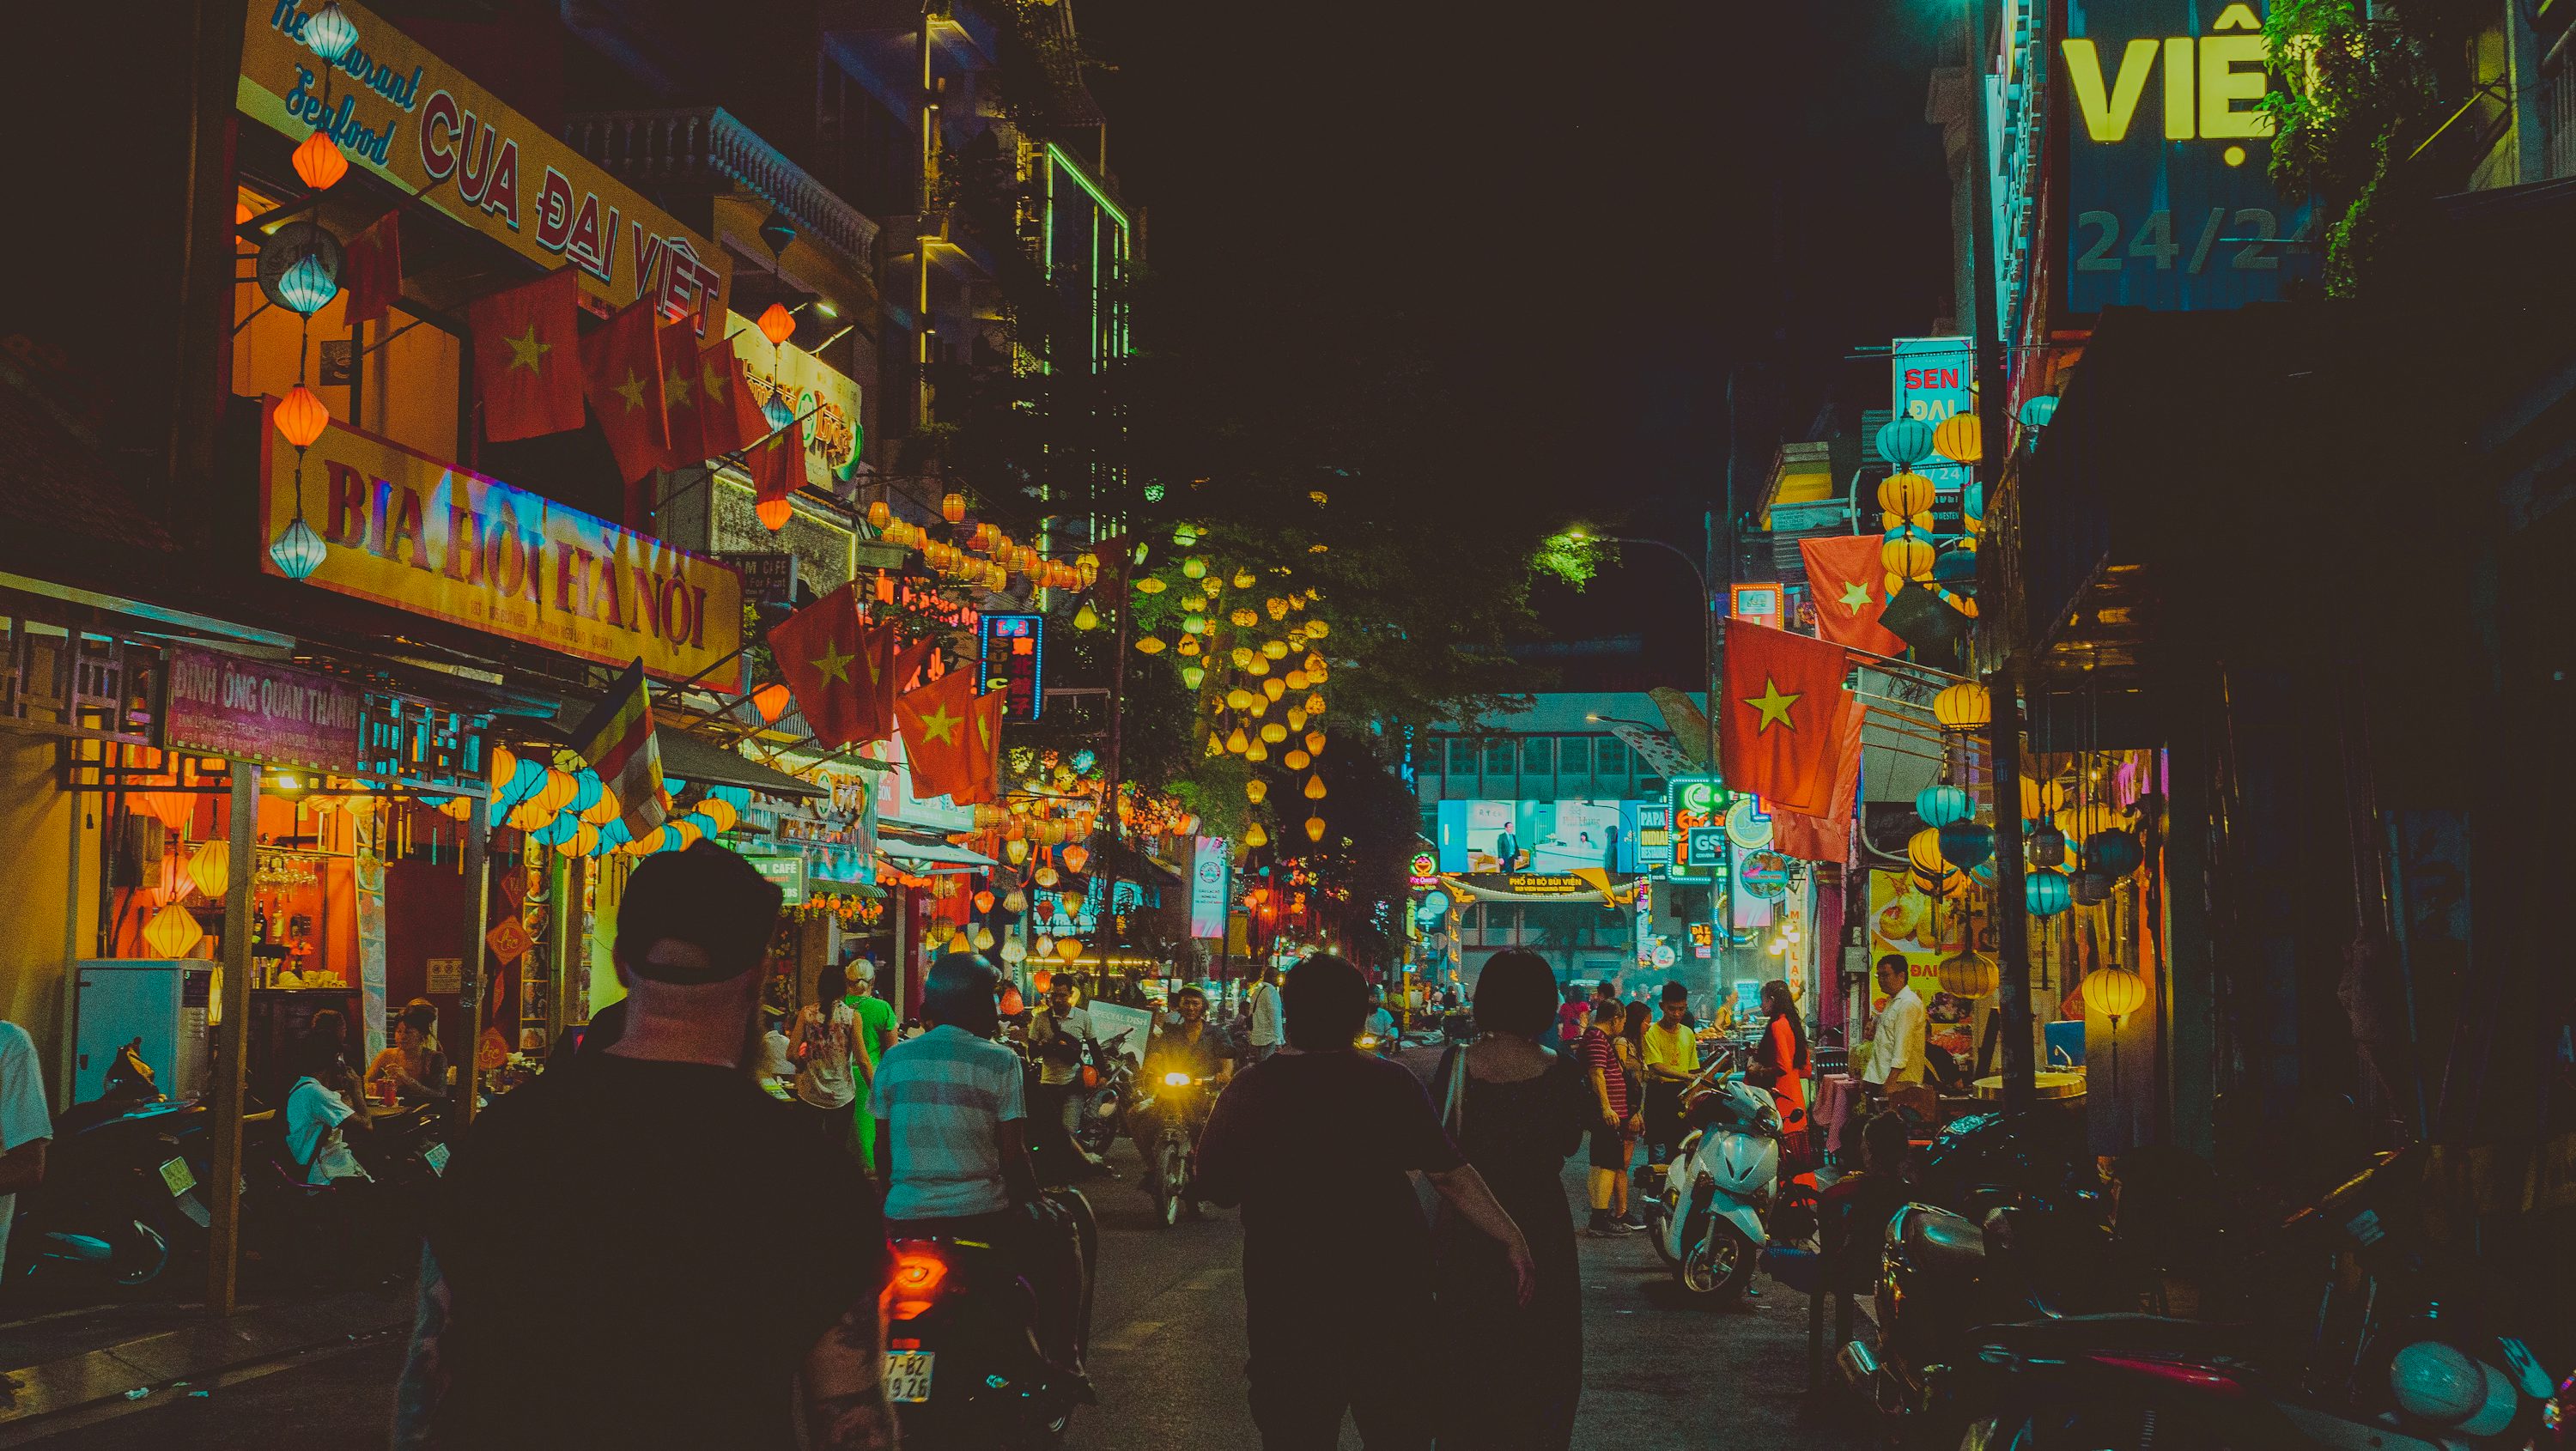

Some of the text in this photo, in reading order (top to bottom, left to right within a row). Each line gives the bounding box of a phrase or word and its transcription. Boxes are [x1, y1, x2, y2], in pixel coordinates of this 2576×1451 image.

[285, 62, 396, 167] Seafood
[419, 89, 721, 338] CUA ĐẠI VIỆT
[1905, 368, 1959, 389] SEN
[1913, 468, 1960, 481] 4/24
[323, 459, 434, 572] BIA
[555, 535, 624, 628] HÀ
[629, 562, 708, 656] NỘI
[222, 661, 257, 712] ÔNG
[261, 678, 304, 720] QUAN
[1641, 811, 1665, 826] PAPA
[772, 861, 797, 874] CAFÉ
[1509, 875, 1526, 885] PHỐ
[1536, 877, 1547, 887] BỘ
[1547, 877, 1561, 885] BÙI
[1562, 877, 1582, 886] VIỆN
[1911, 964, 1938, 980] ĐẠI
